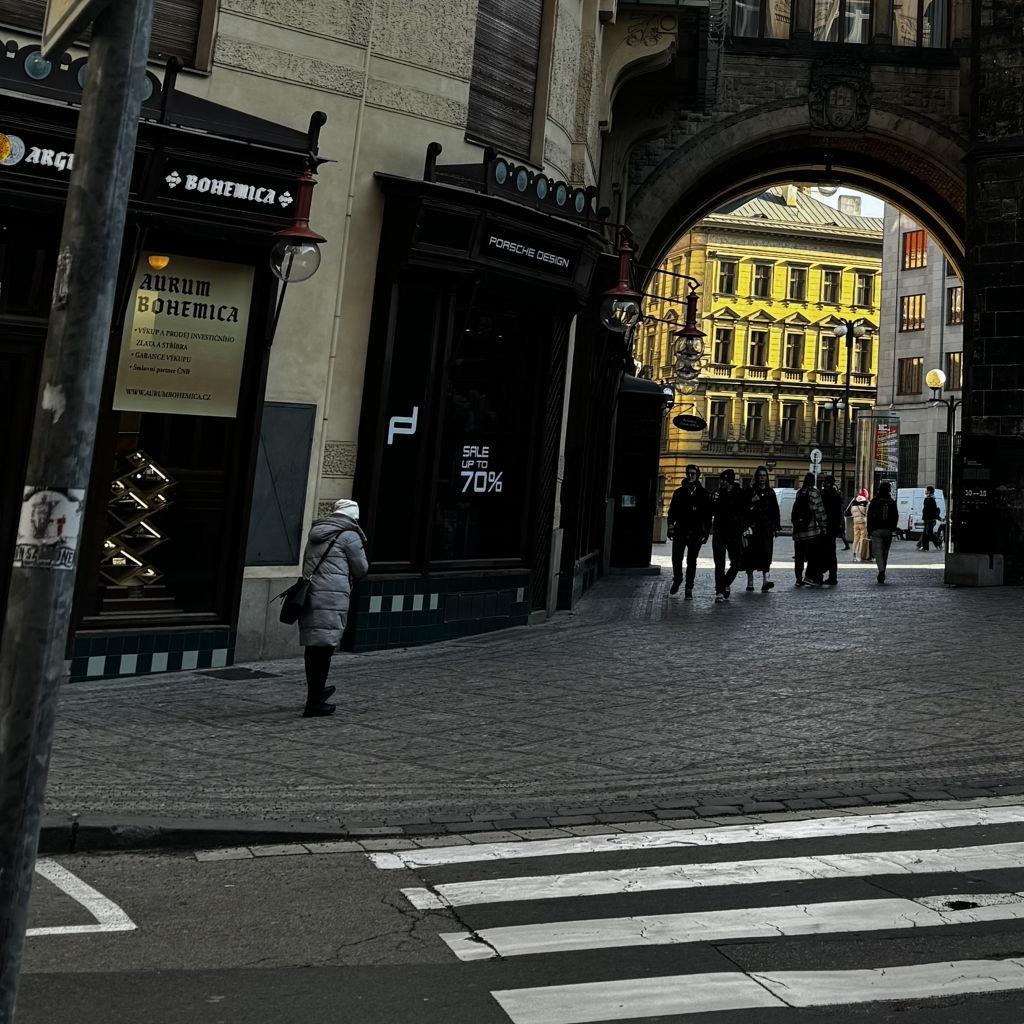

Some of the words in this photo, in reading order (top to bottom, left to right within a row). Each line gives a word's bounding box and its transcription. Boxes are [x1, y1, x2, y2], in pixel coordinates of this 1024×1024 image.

[185, 175, 276, 204] BOHEMICA
[489, 236, 535, 257] PORSCHE
[537, 250, 570, 267] DESIGN
[139, 274, 211, 297] AURUM
[138, 296, 239, 323] BOHEMICA
[462, 445, 490, 458] SALE
[461, 460, 474, 468] UP
[476, 460, 488, 468] TO
[460, 471, 503, 492] 70%
